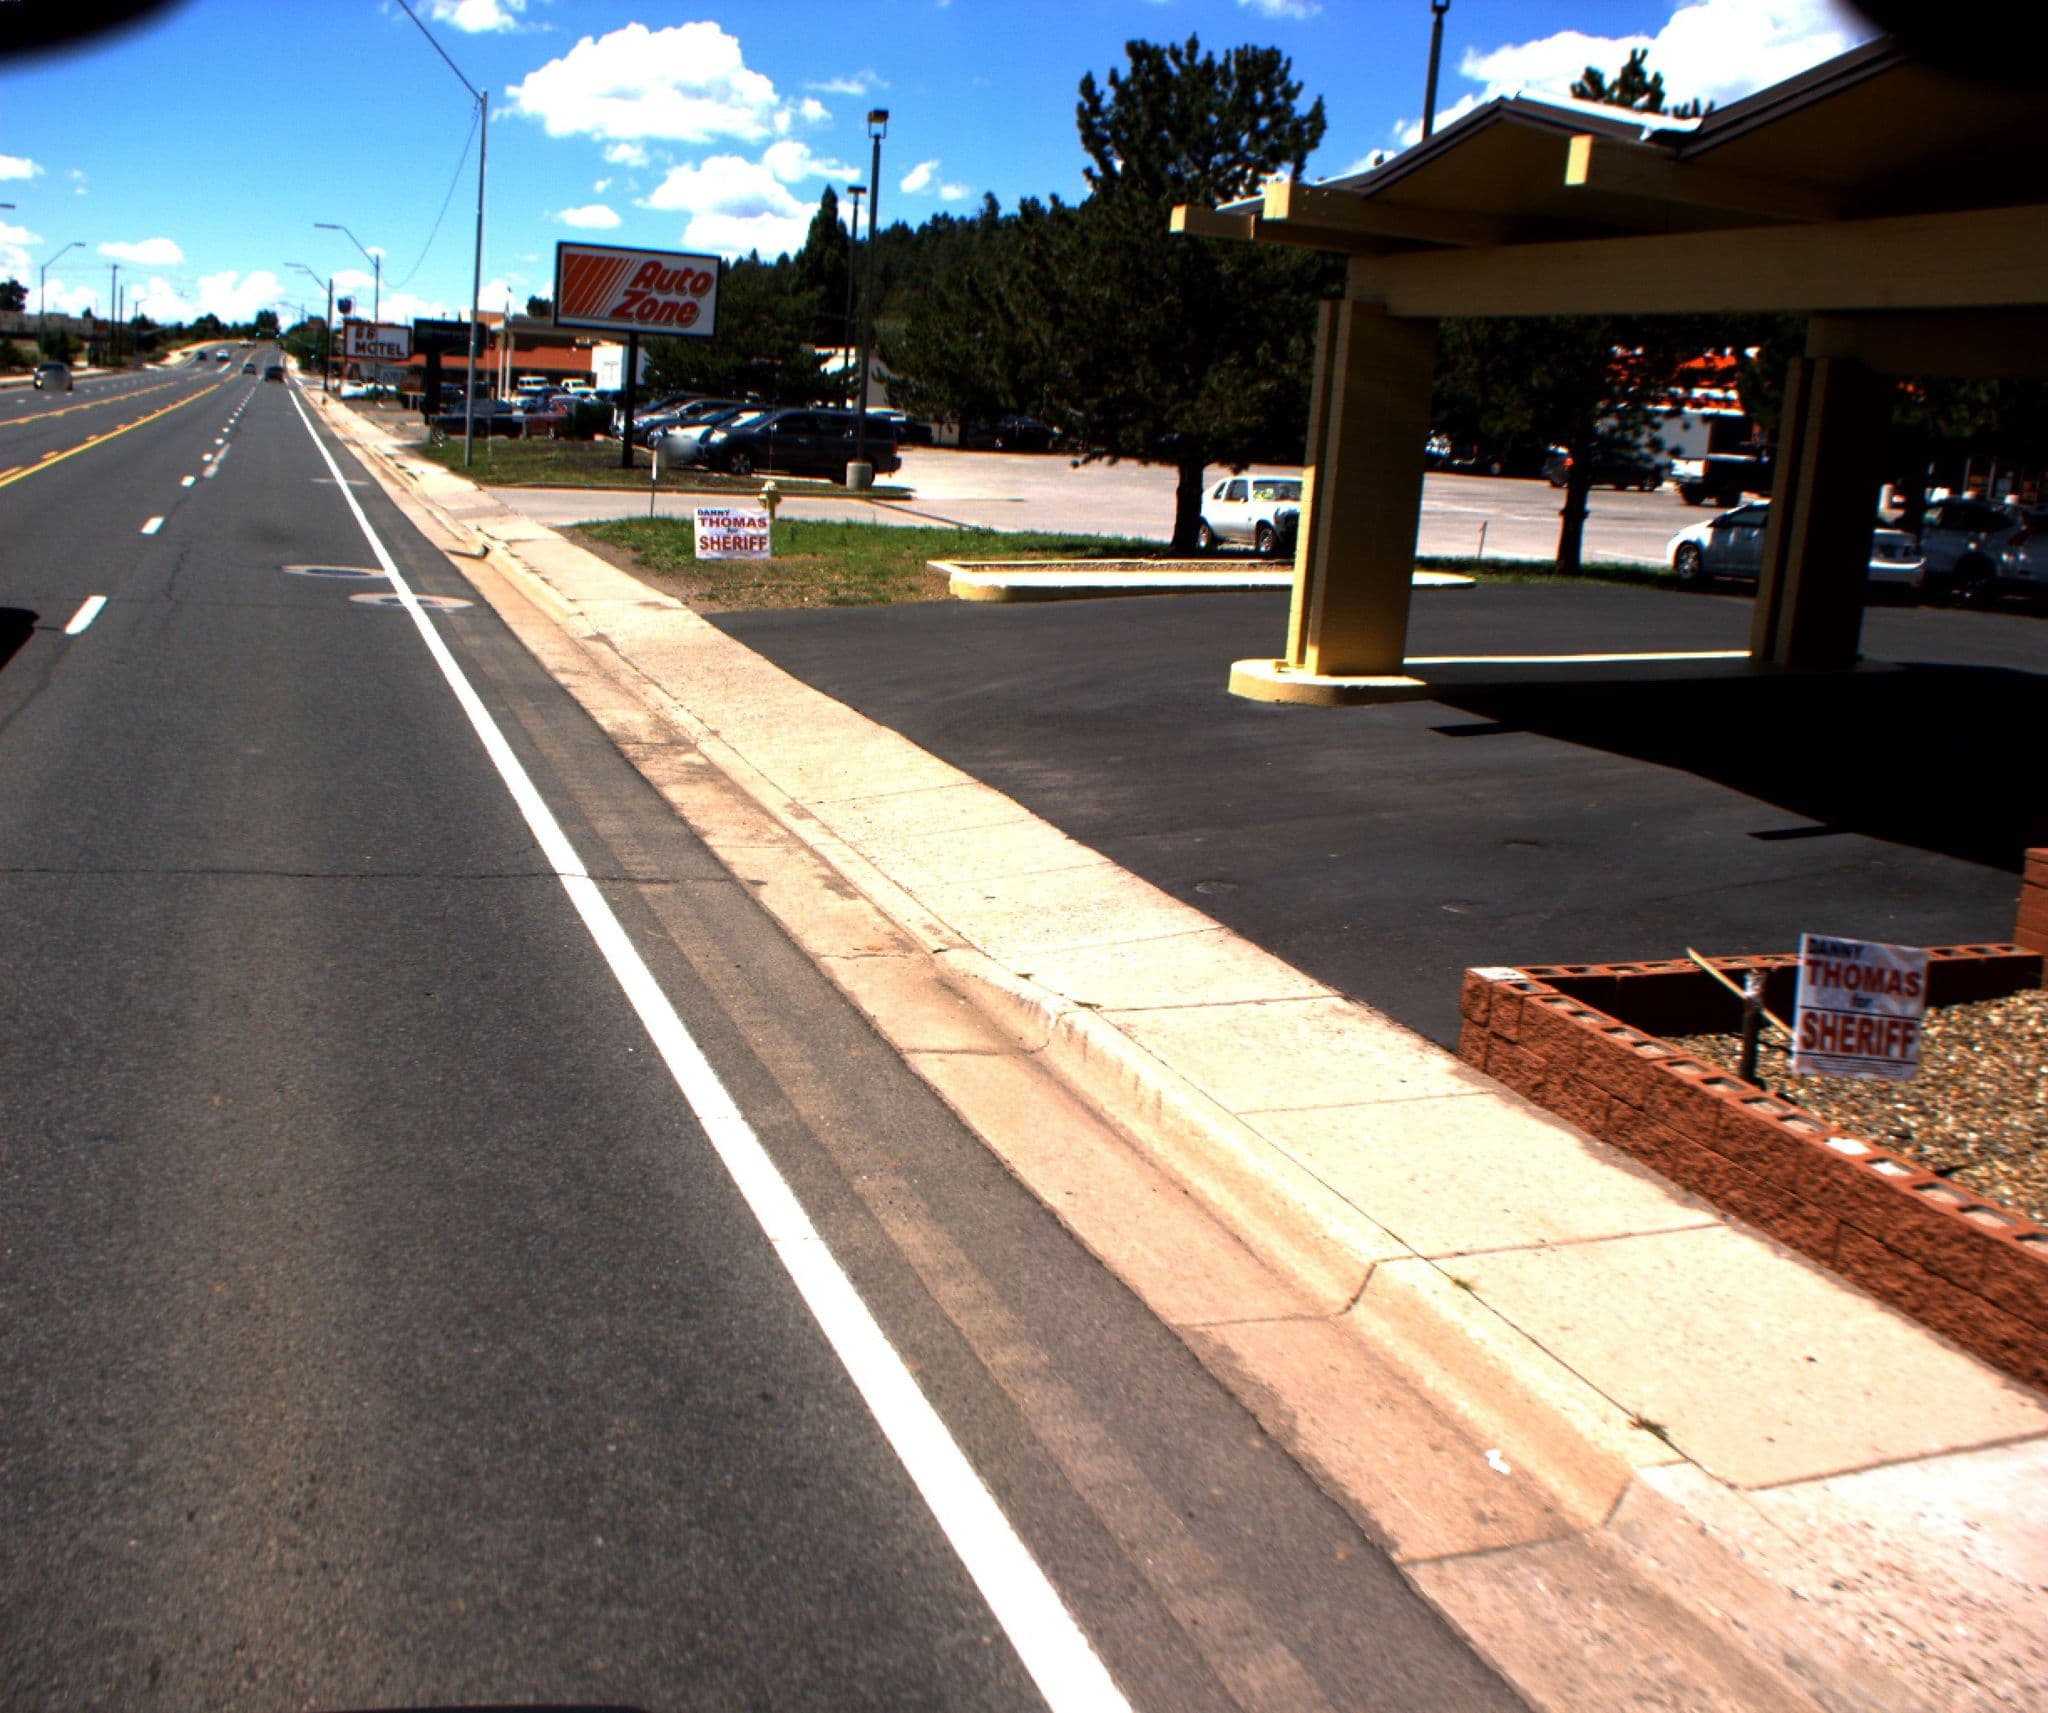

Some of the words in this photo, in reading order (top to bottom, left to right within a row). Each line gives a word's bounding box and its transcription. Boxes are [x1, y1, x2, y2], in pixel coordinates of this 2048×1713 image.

[632, 260, 714, 298] Auto
[608, 289, 701, 328] Zone
[355, 341, 405, 357] MOTEL
[699, 517, 767, 528] THOMAS
[699, 535, 767, 551] SHERIFF
[1805, 959, 1920, 997] THOMAS
[1800, 1012, 1917, 1059] SHERIFF
